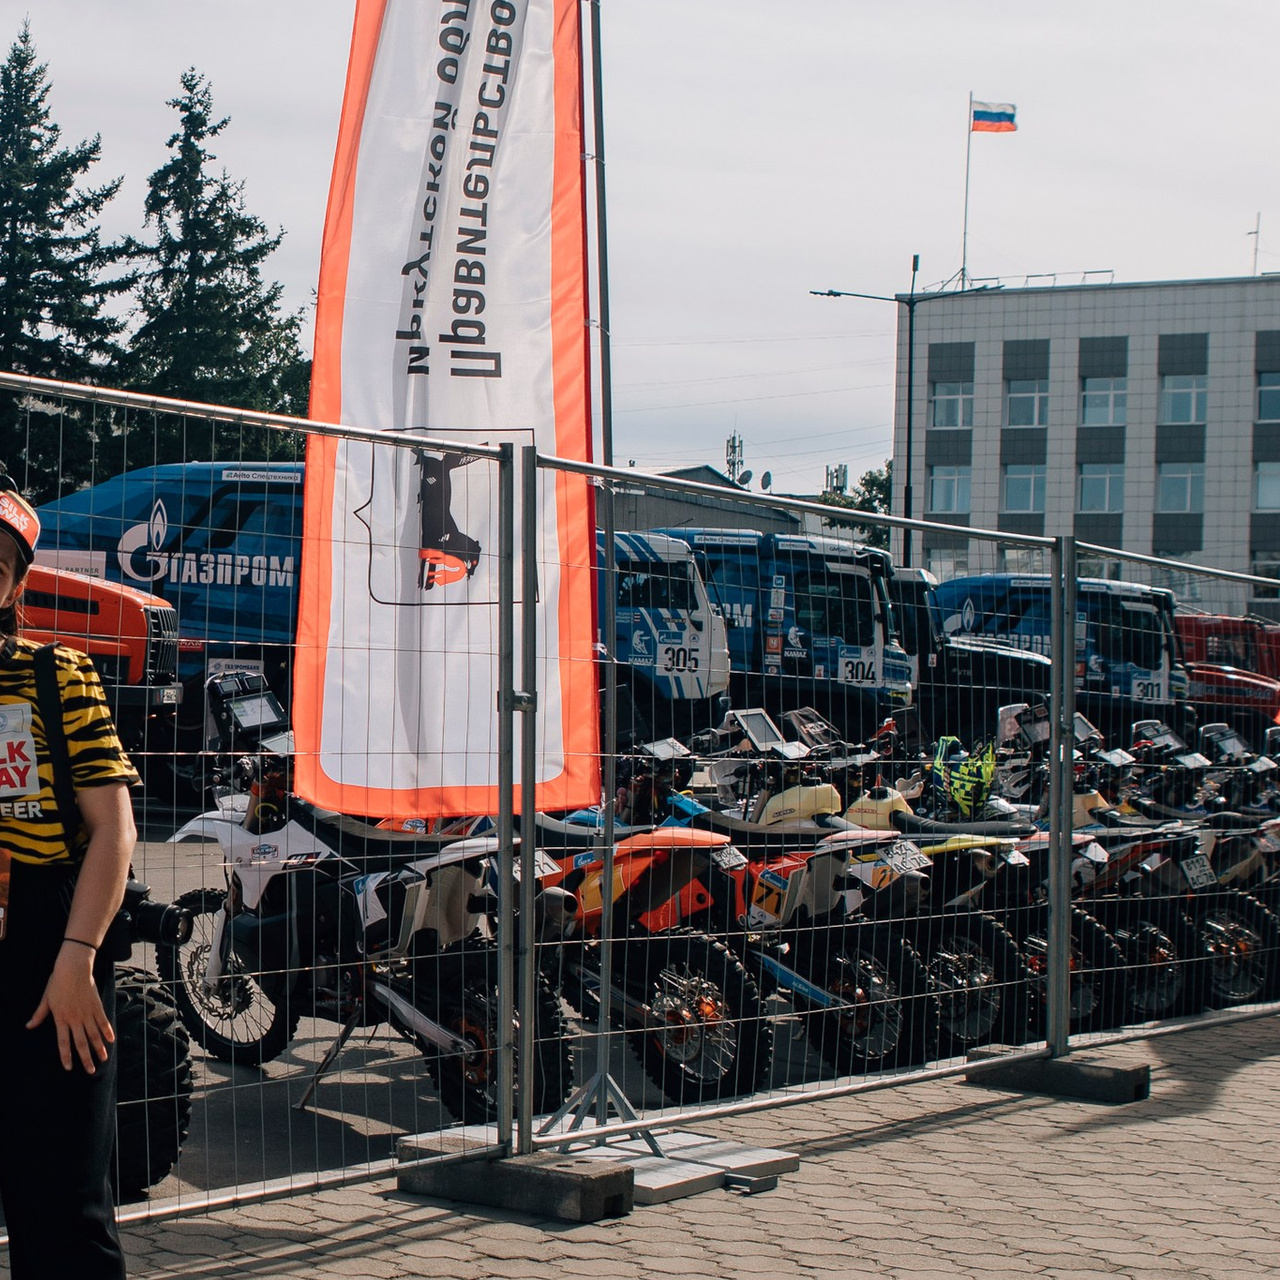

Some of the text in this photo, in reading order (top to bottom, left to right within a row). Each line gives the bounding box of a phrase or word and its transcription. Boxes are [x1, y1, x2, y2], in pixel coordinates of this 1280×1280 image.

[0, 497, 29, 524] SILK
[170, 553, 295, 587] ГАЗПРОМ
[663, 647, 700, 673] 305
[784, 650, 808, 658] KAMAZ
[845, 661, 876, 684] 304
[1136, 682, 1161, 701] 301
[755, 881, 782, 915] 71
